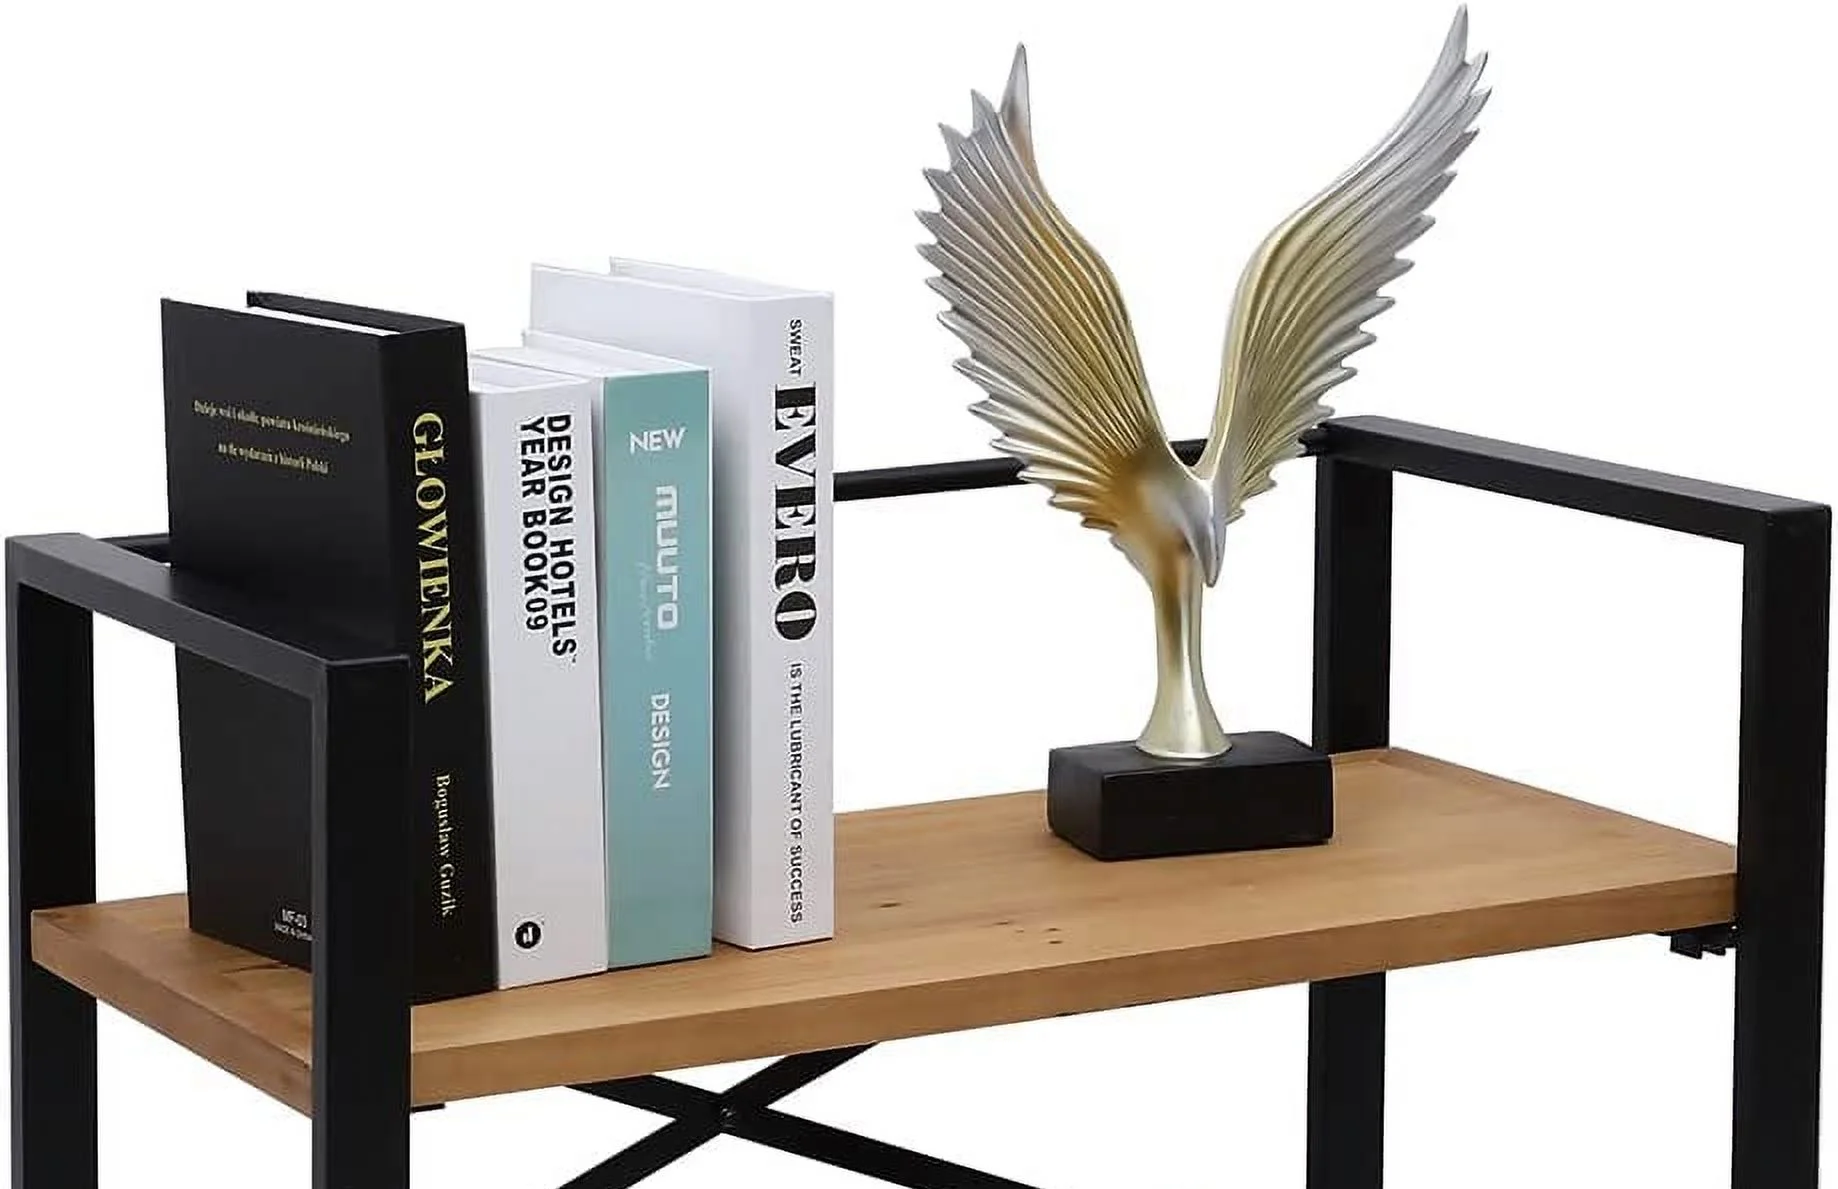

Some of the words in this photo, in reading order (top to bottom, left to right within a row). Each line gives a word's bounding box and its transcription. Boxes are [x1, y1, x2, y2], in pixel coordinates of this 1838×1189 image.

[789, 319, 802, 377] SWEAT
[521, 416, 546, 498] YEAR
[547, 414, 574, 526] DESIGN
[629, 427, 686, 454] NEW
[775, 381, 817, 640] EVERO
[789, 663, 802, 679] IS
[789, 682, 802, 715] THE
[651, 692, 671, 790] DESIGN
[789, 719, 802, 814] LUBRICANT
[789, 818, 802, 840] OF
[439, 863, 457, 917] Guzik
[789, 844, 803, 923] SUCCESS
